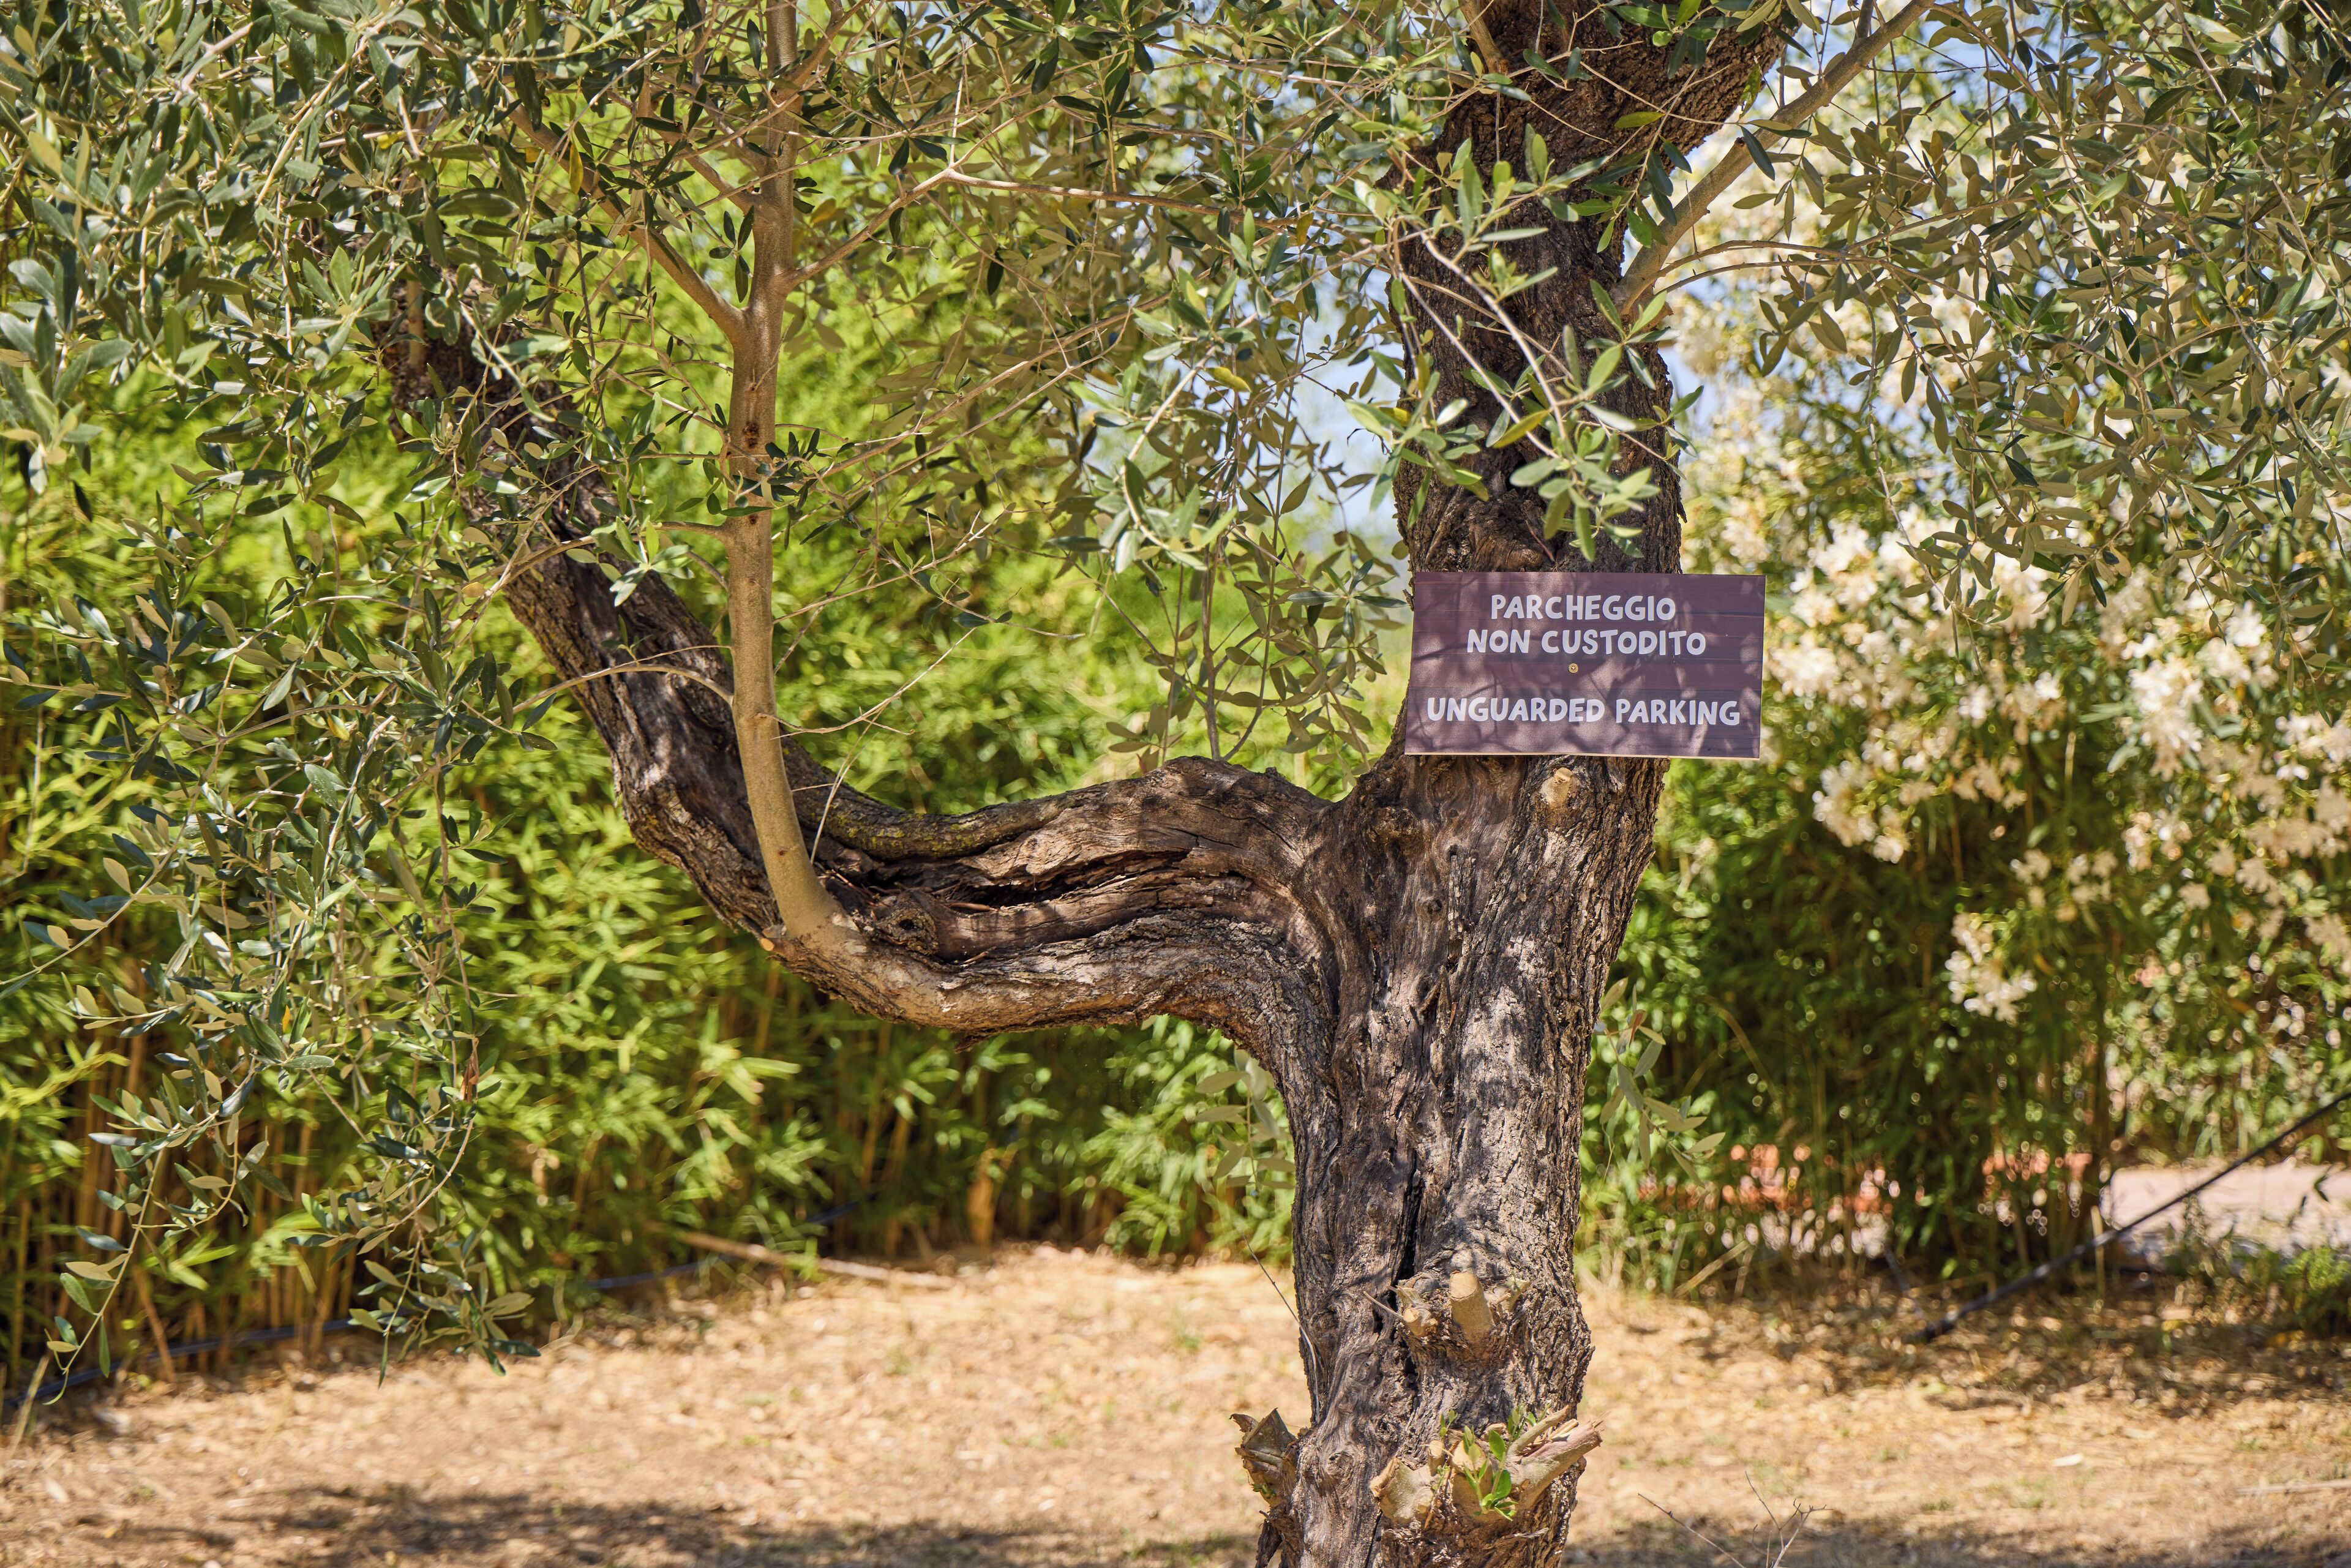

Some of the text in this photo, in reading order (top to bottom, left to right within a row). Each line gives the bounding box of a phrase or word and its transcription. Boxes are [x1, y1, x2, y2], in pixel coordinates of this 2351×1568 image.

[1490, 594, 1676, 621] PARCHEGGIO
[1467, 628, 1707, 656] NON CUSTODITO
[1427, 696, 1741, 726] UNGUARDED PARKING
